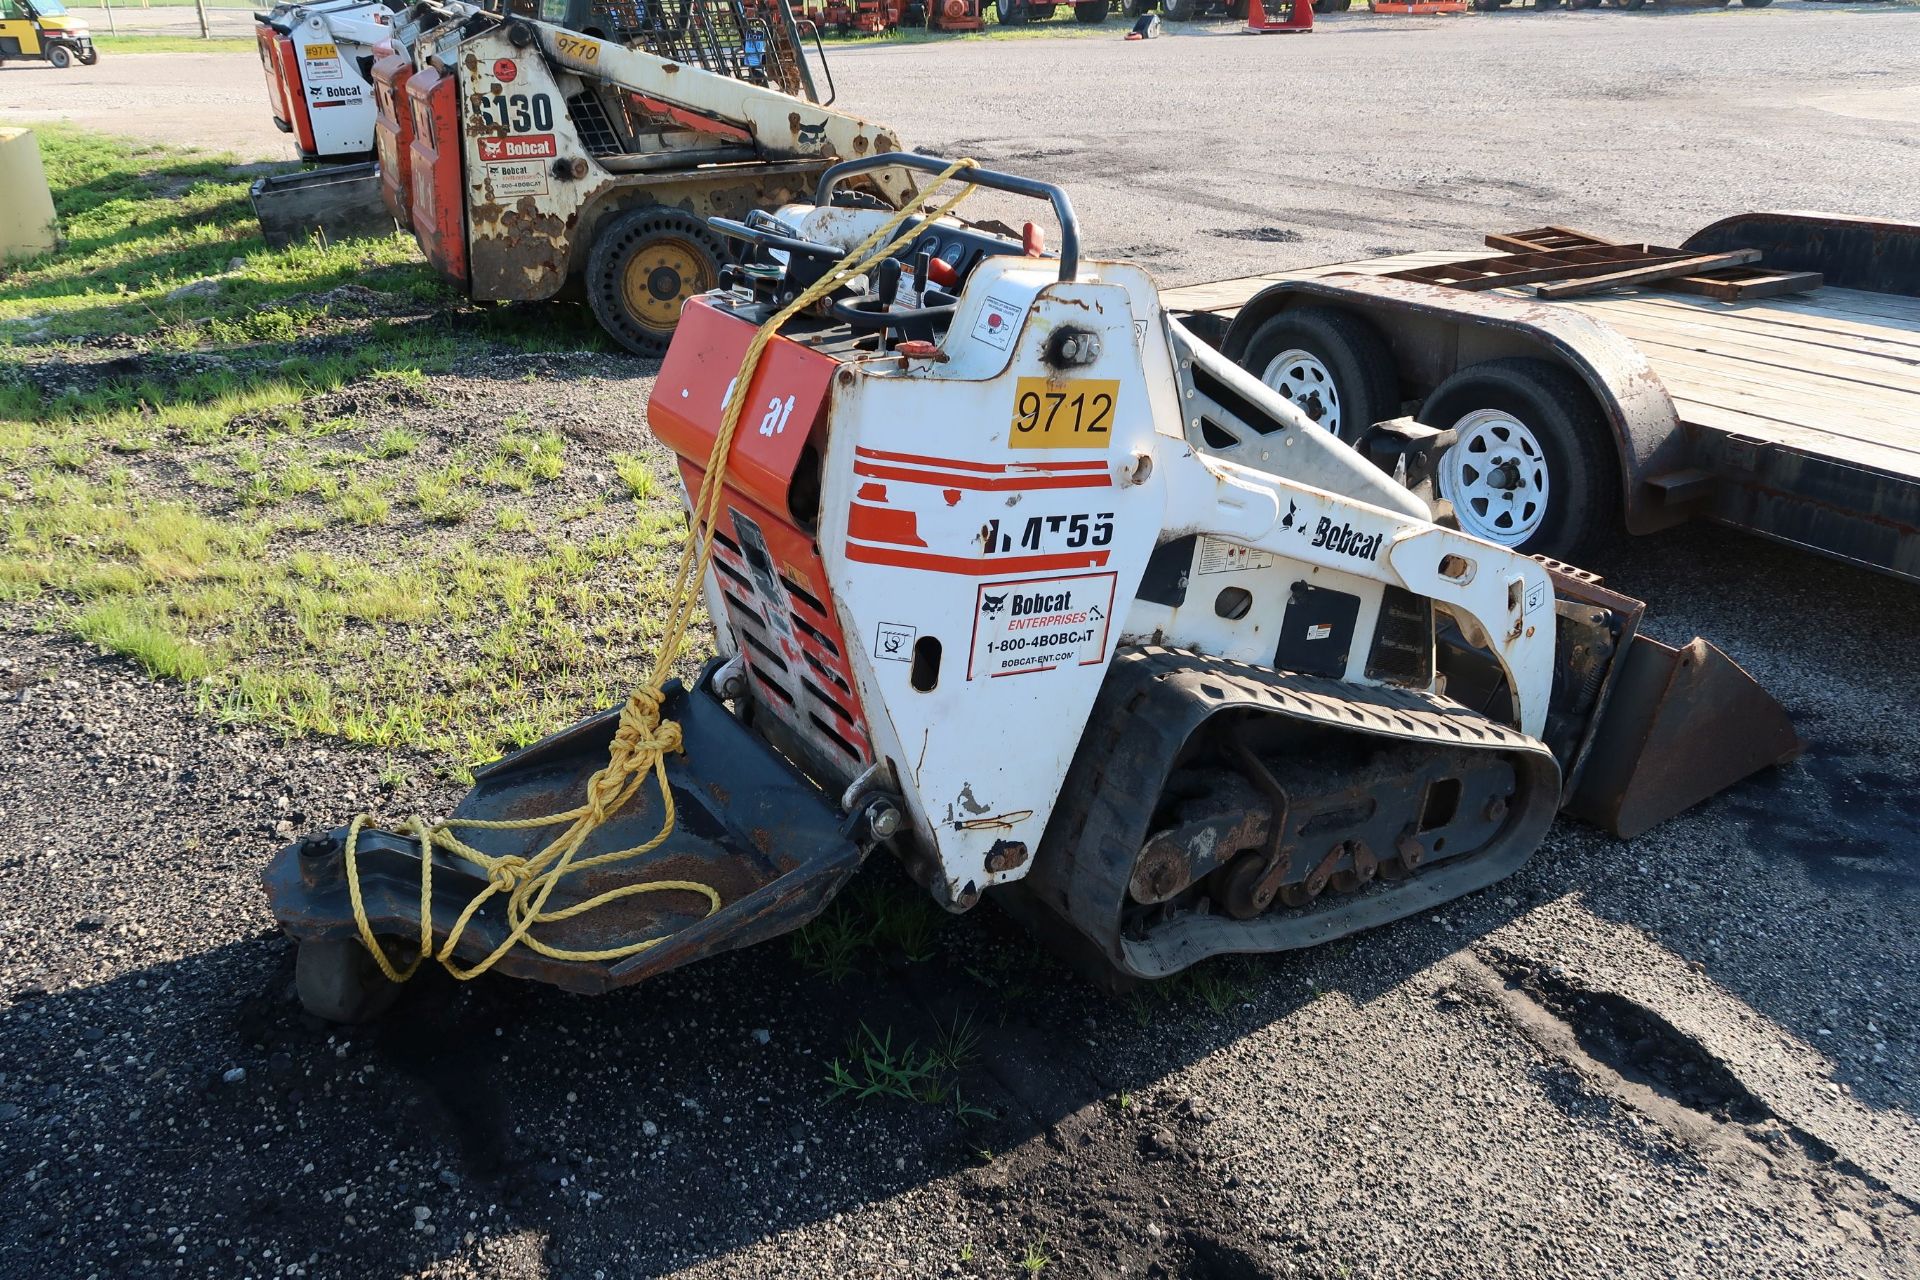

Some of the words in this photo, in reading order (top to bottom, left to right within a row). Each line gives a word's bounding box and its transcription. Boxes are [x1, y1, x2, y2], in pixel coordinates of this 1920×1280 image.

[305, 46, 336, 56] #9714
[558, 38, 597, 60] 9710
[326, 85, 361, 98] Bobcat
[505, 141, 550, 156] Bobcat
[502, 166, 528, 176] Bobcat
[1017, 391, 1112, 433] 9712
[1311, 516, 1384, 561] Bobcat
[1011, 590, 1072, 616] Bobcat
[1008, 612, 1087, 631] ENTERPRISES
[987, 629, 1095, 653] 1-800-4BOBCAT
